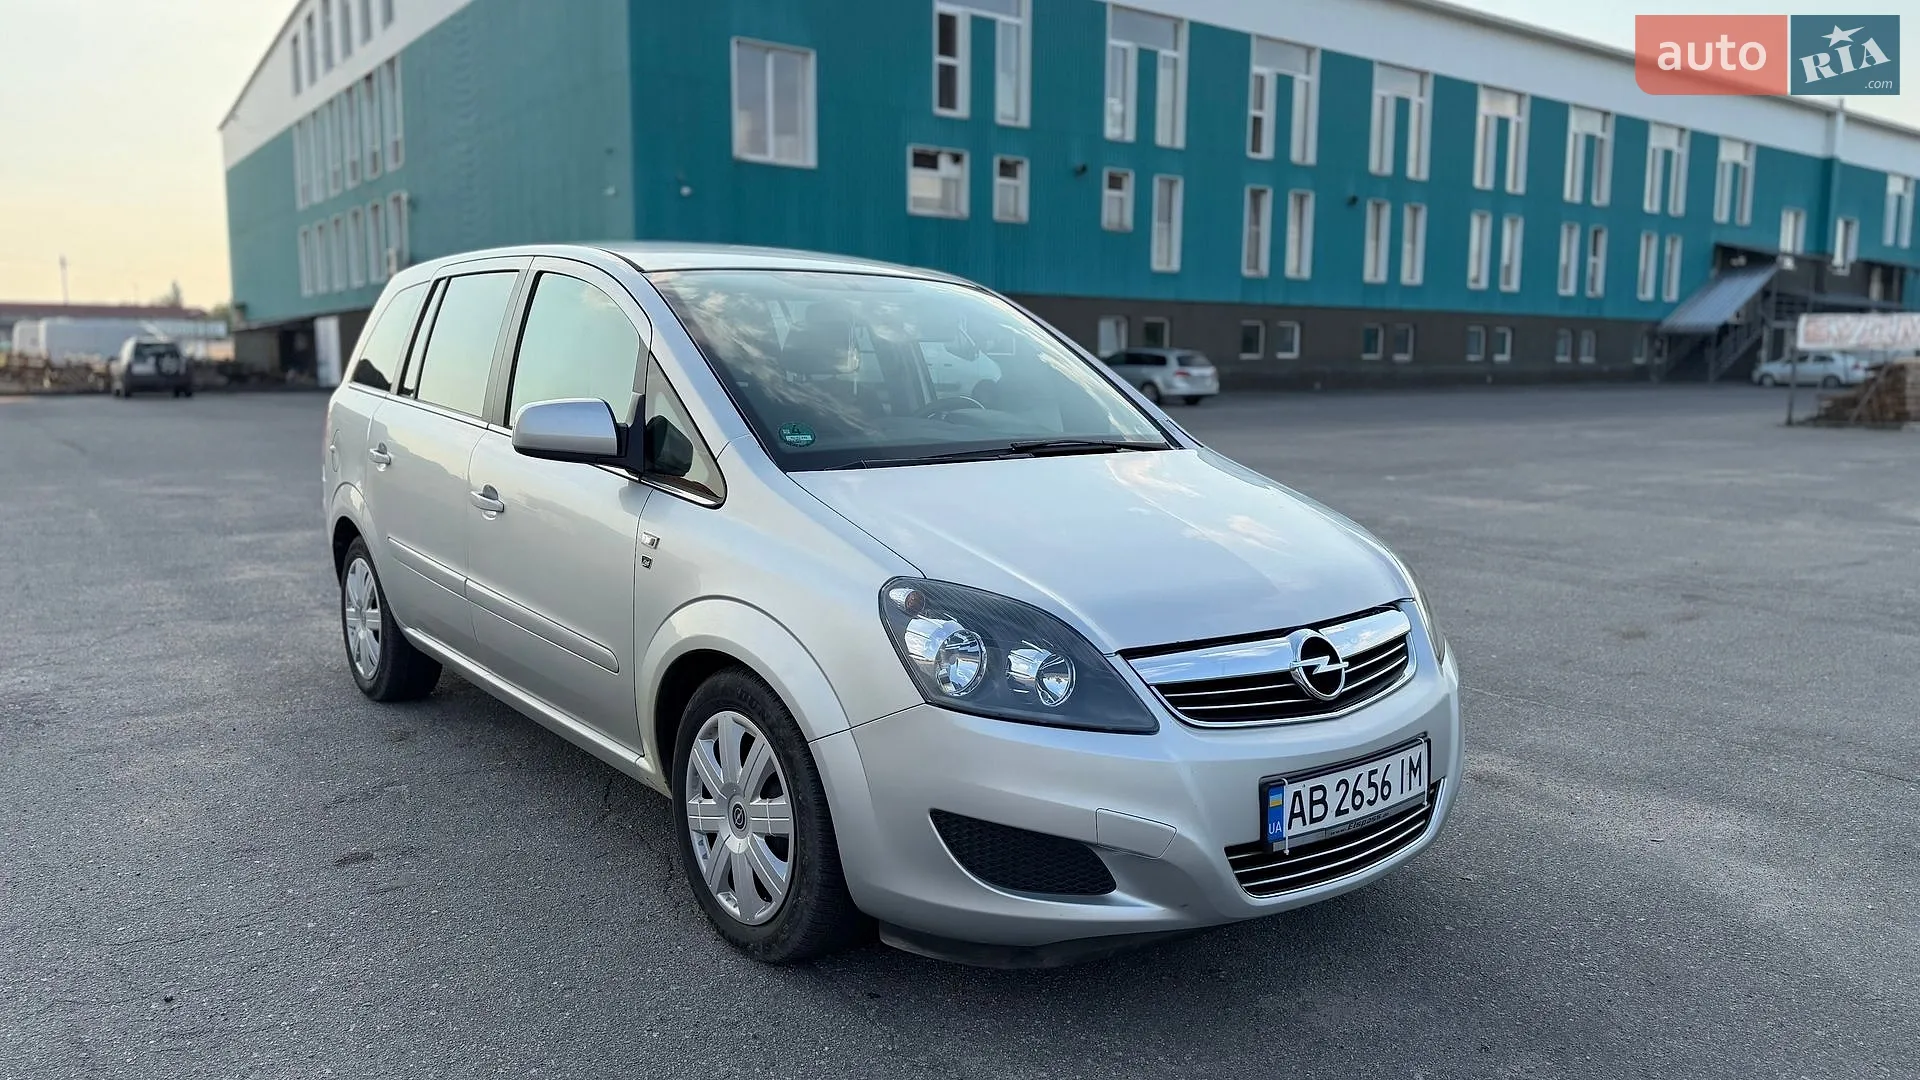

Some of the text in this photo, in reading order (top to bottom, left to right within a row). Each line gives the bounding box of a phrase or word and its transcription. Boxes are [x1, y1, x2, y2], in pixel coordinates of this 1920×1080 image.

[1287, 751, 1422, 831] AB 2656 IM
[1268, 820, 1283, 835] UA
